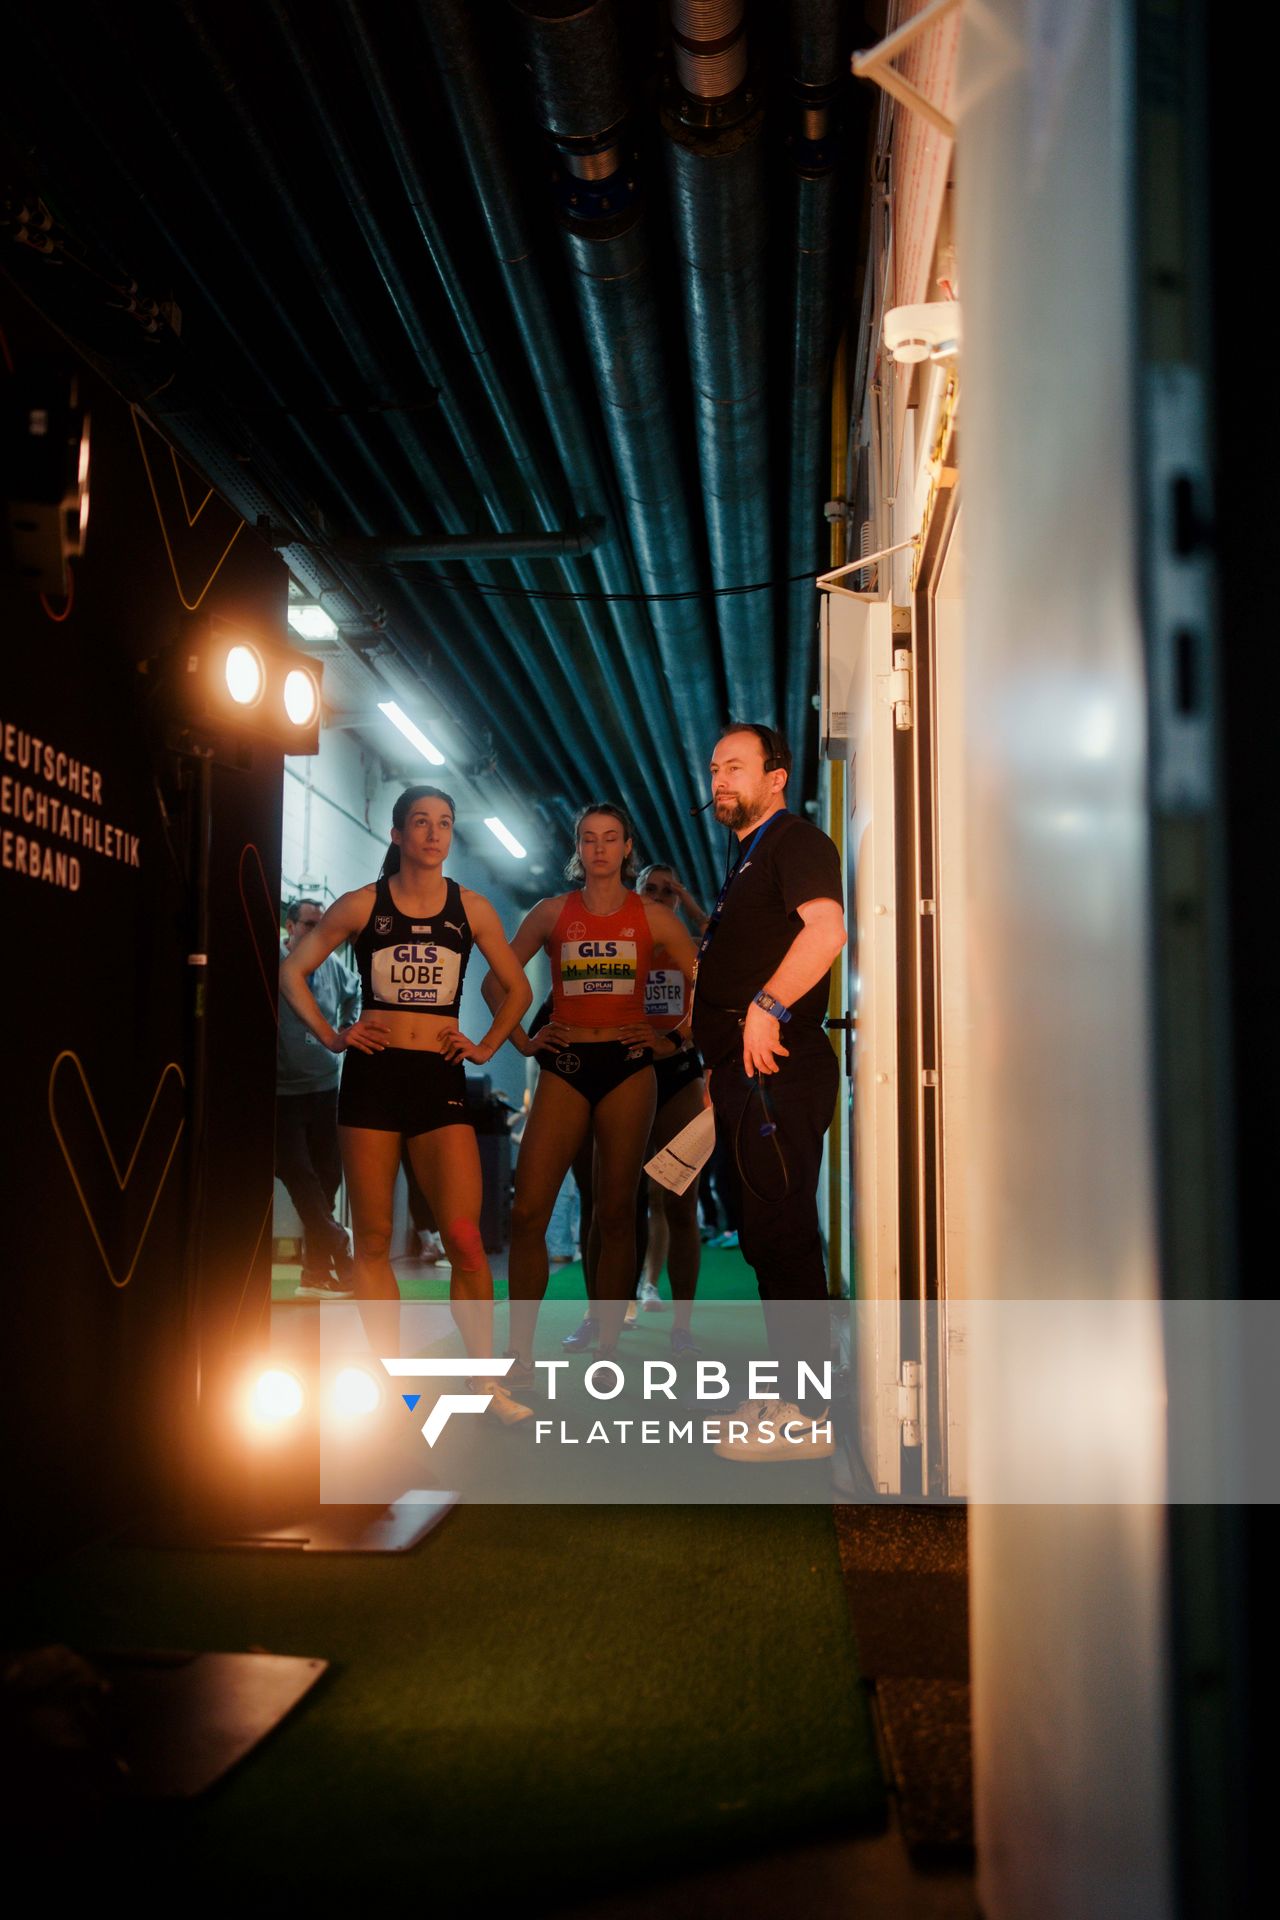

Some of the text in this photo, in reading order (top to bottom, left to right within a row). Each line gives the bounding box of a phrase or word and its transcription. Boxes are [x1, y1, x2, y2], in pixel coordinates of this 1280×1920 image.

[0, 720, 102, 805] EUTSCHER
[0, 776, 140, 868] EICHTATHLETIK
[0, 828, 81, 892] ERBAND
[394, 945, 438, 963] GLS
[578, 942, 617, 958] GLS
[390, 965, 443, 984] LOBE
[566, 963, 631, 977] M. MEIER
[646, 971, 666, 985] LS
[645, 985, 681, 1000] USTER
